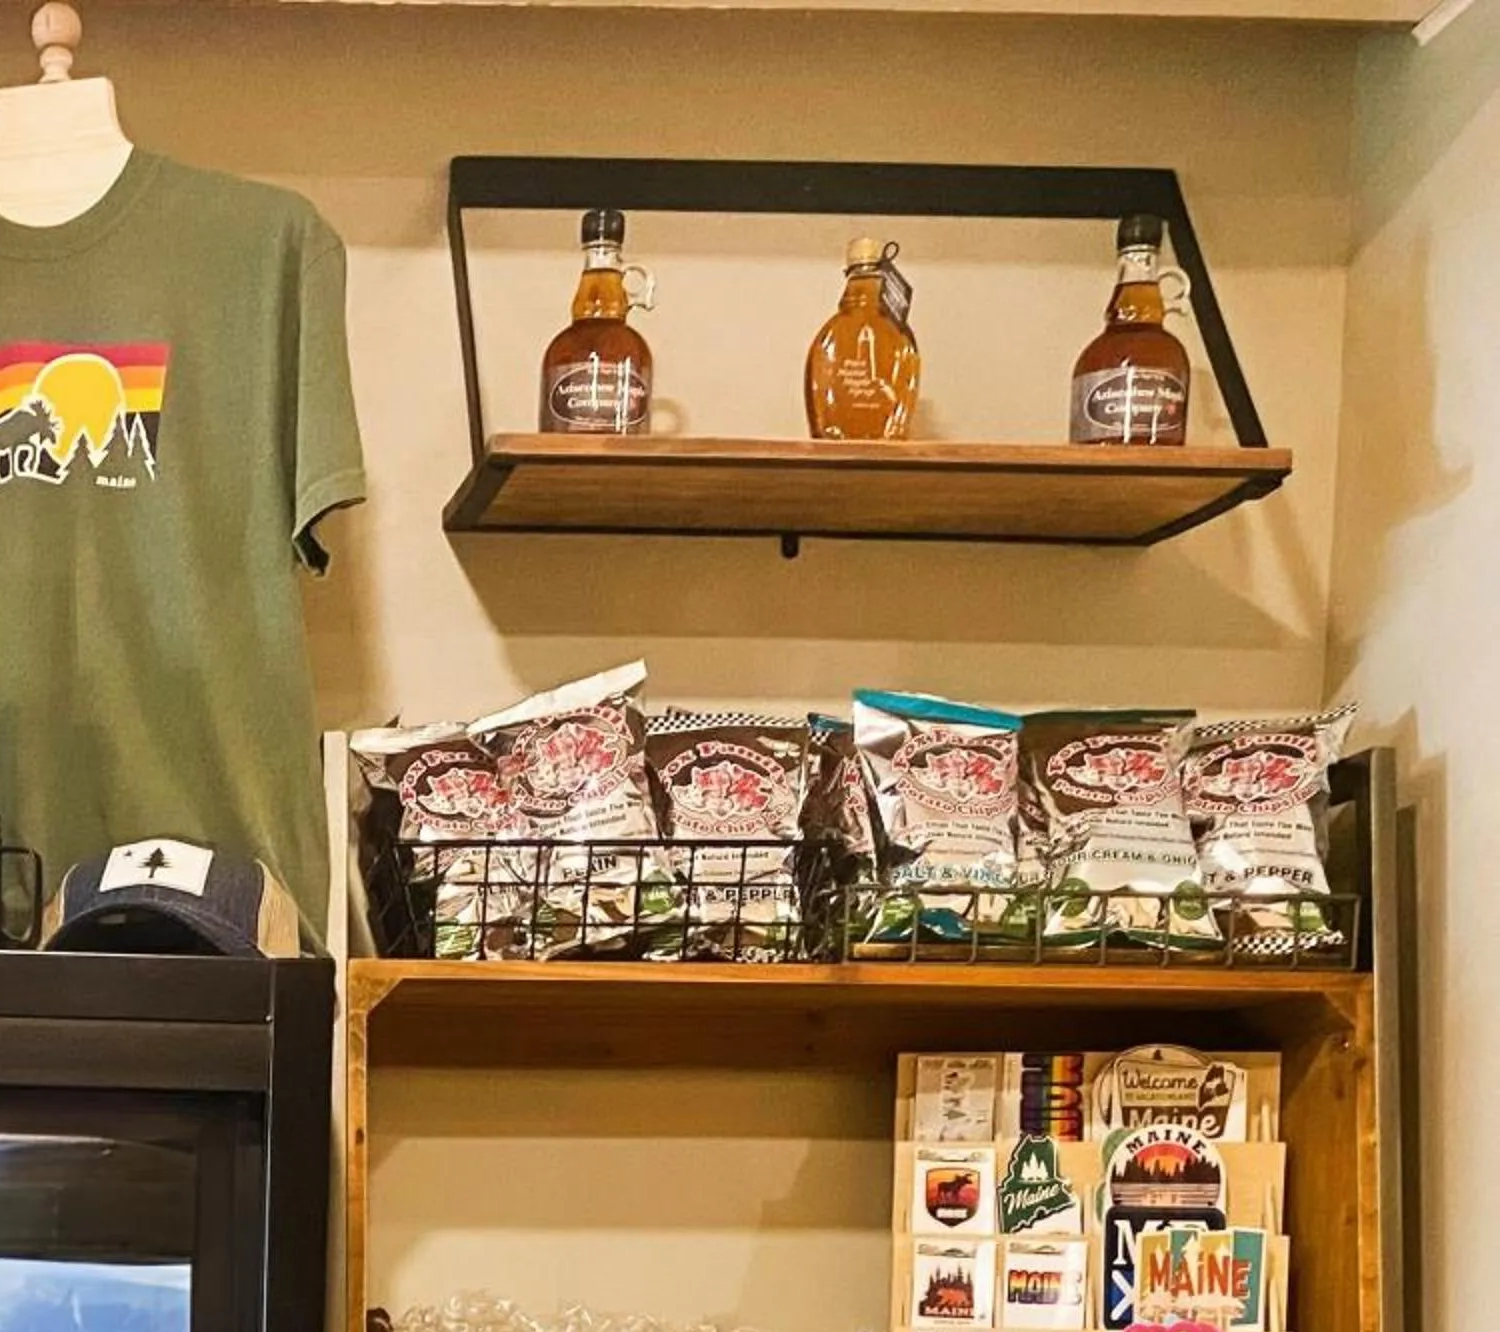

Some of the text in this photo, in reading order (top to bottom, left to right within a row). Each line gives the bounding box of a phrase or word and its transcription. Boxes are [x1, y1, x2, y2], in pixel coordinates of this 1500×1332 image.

[1091, 849, 1143, 862] CREAM
[1161, 853, 1198, 866] ONIO
[1243, 866, 1314, 885] PEPPER
[1121, 1067, 1199, 1090] Welcome
[1125, 1129, 1207, 1154] MAINE
[1003, 1183, 1060, 1215] Maine
[1149, 1251, 1251, 1298] MAINE
